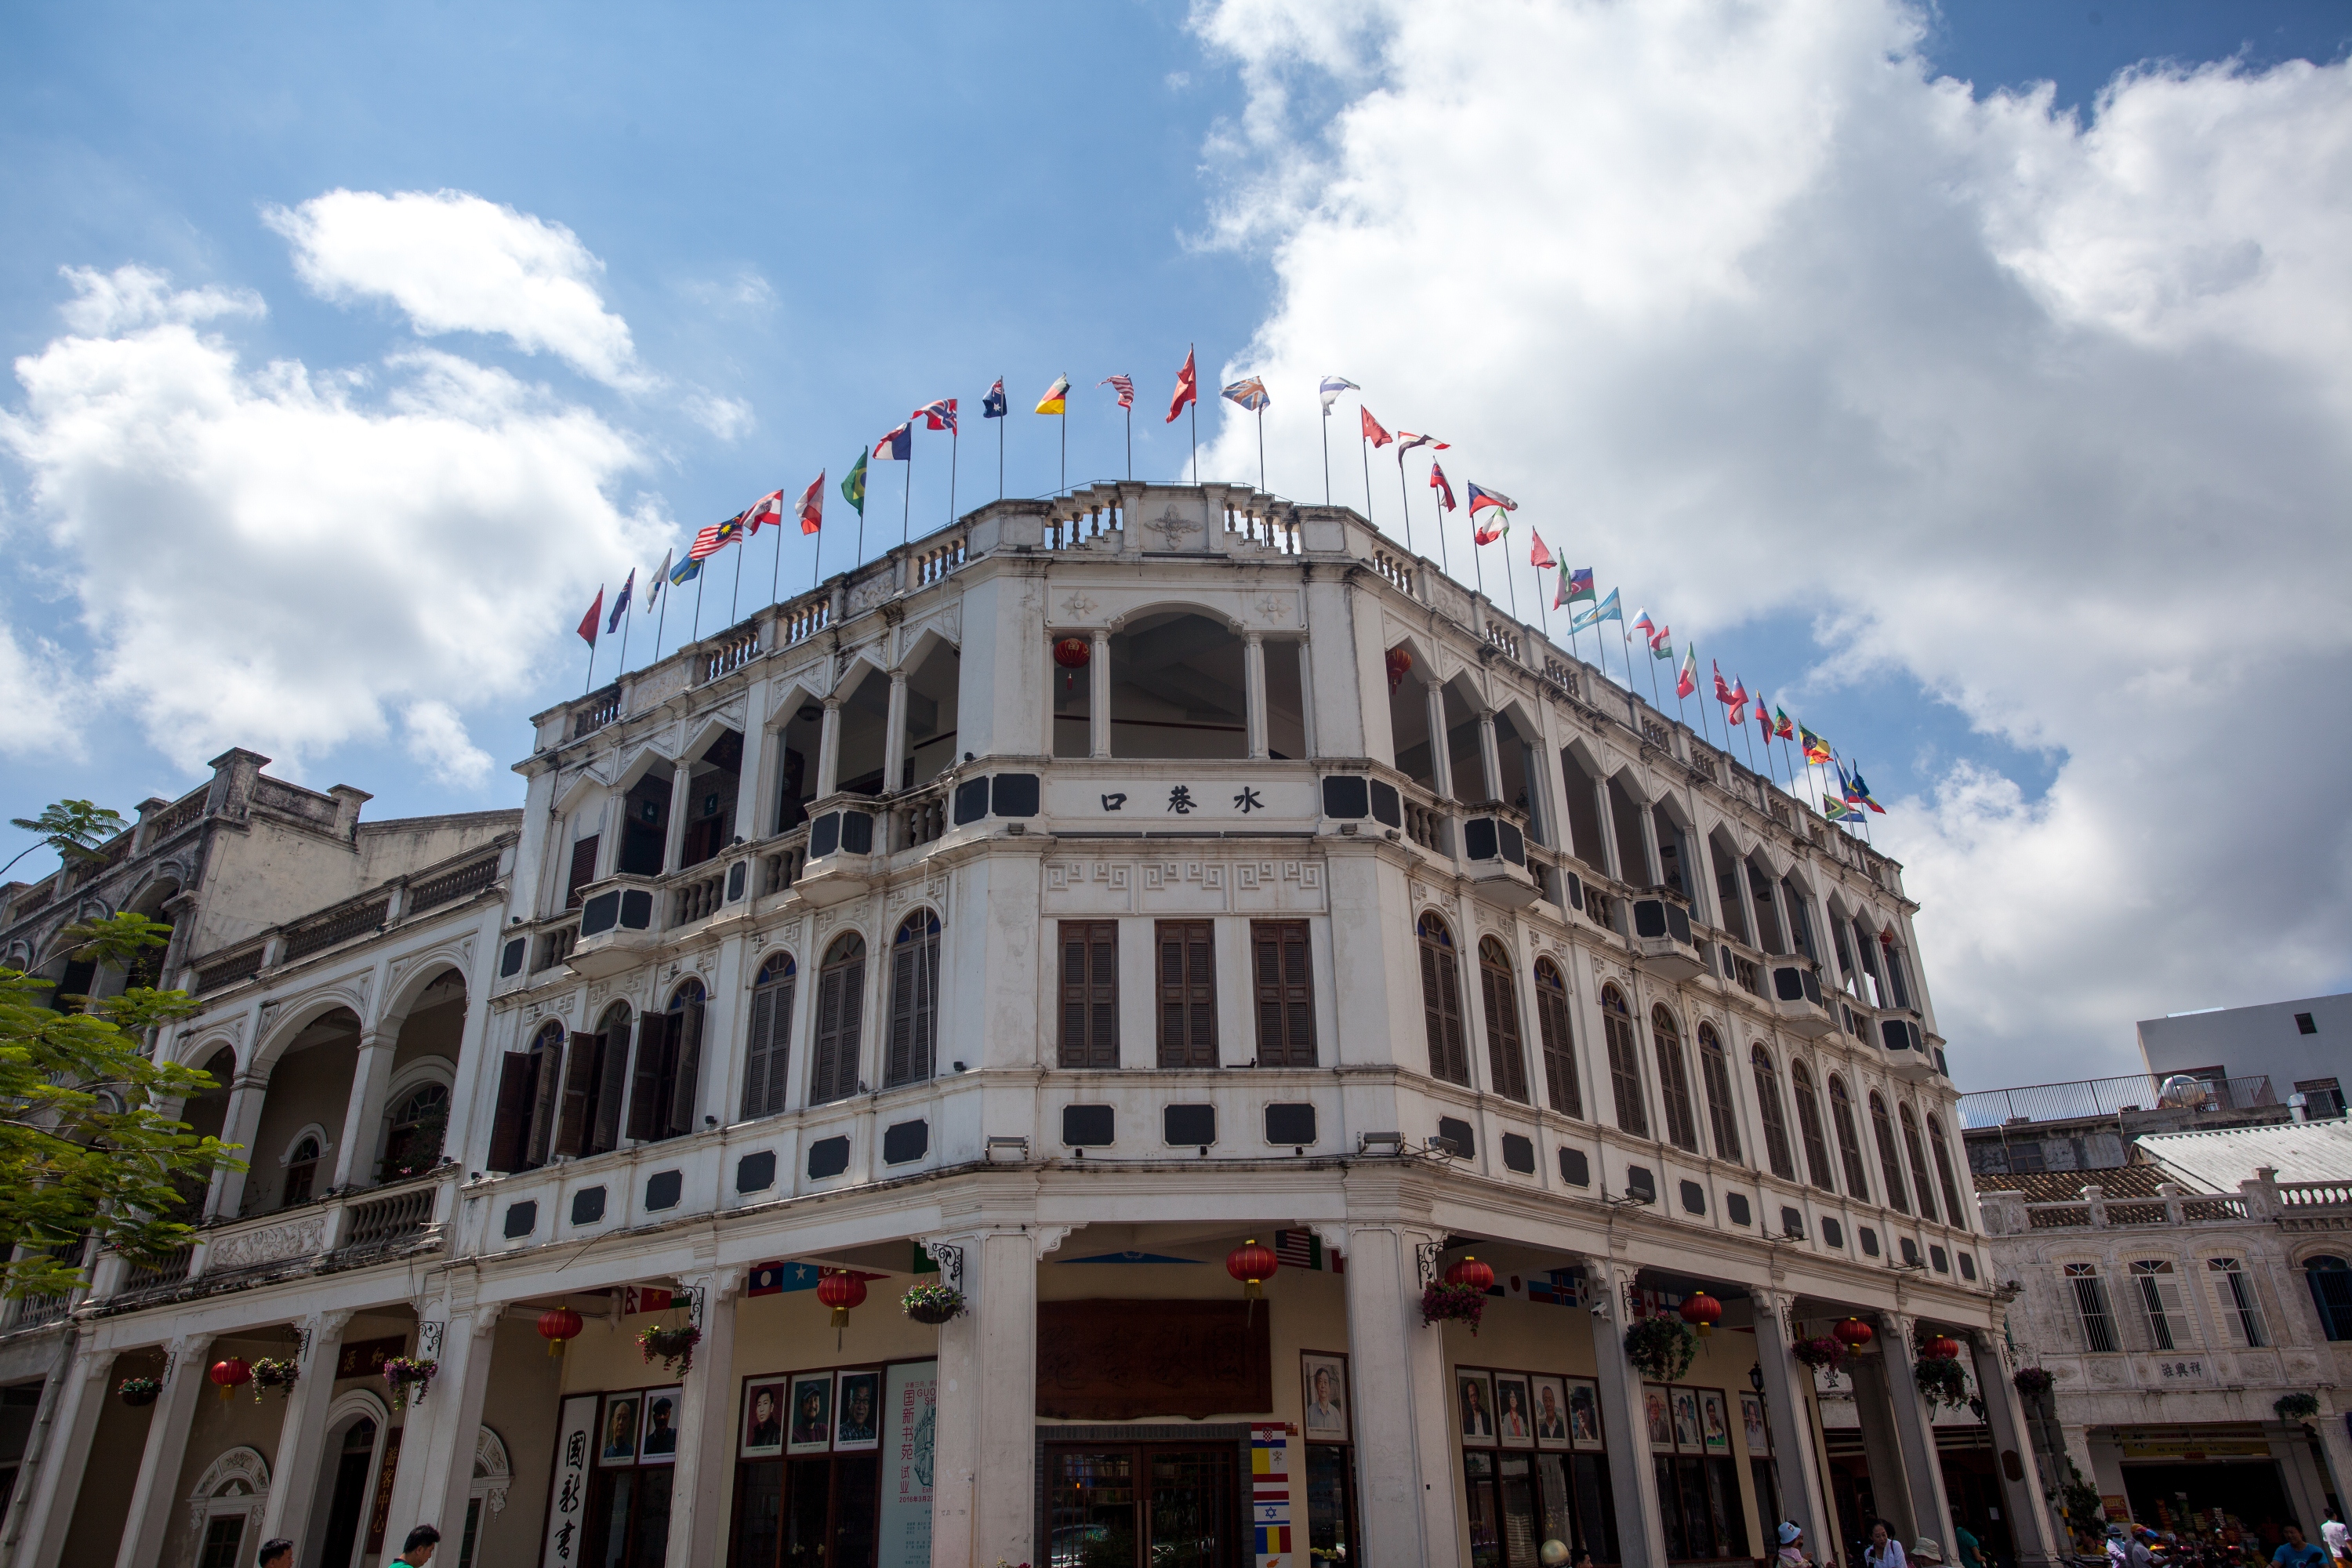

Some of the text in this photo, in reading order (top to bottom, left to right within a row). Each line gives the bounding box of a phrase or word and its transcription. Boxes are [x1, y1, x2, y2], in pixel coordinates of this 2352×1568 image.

[1101, 785, 1265, 815] 水巷口
[901, 1389, 915, 1461] 国新书苑
[373, 1446, 397, 1534] 游客中心
[554, 1430, 586, 1568] 國新書
